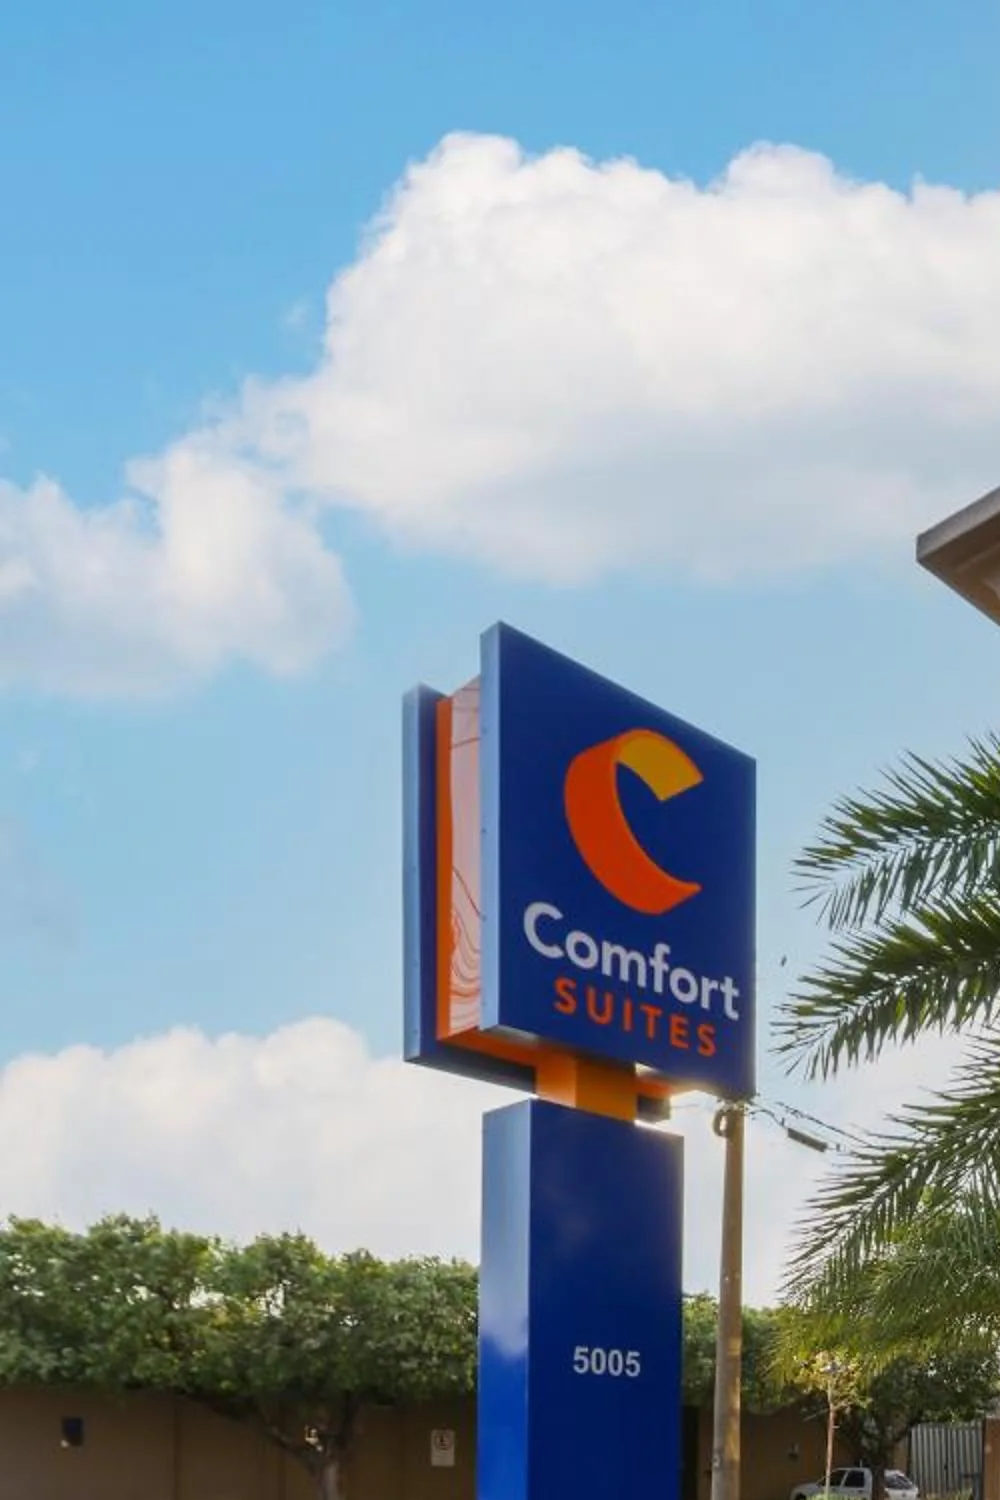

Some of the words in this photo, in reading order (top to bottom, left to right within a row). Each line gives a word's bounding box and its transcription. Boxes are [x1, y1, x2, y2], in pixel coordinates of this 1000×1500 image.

[523, 901, 740, 1022] Comfort
[554, 977, 716, 1057] SUITES
[573, 1345, 641, 1377] 5005
